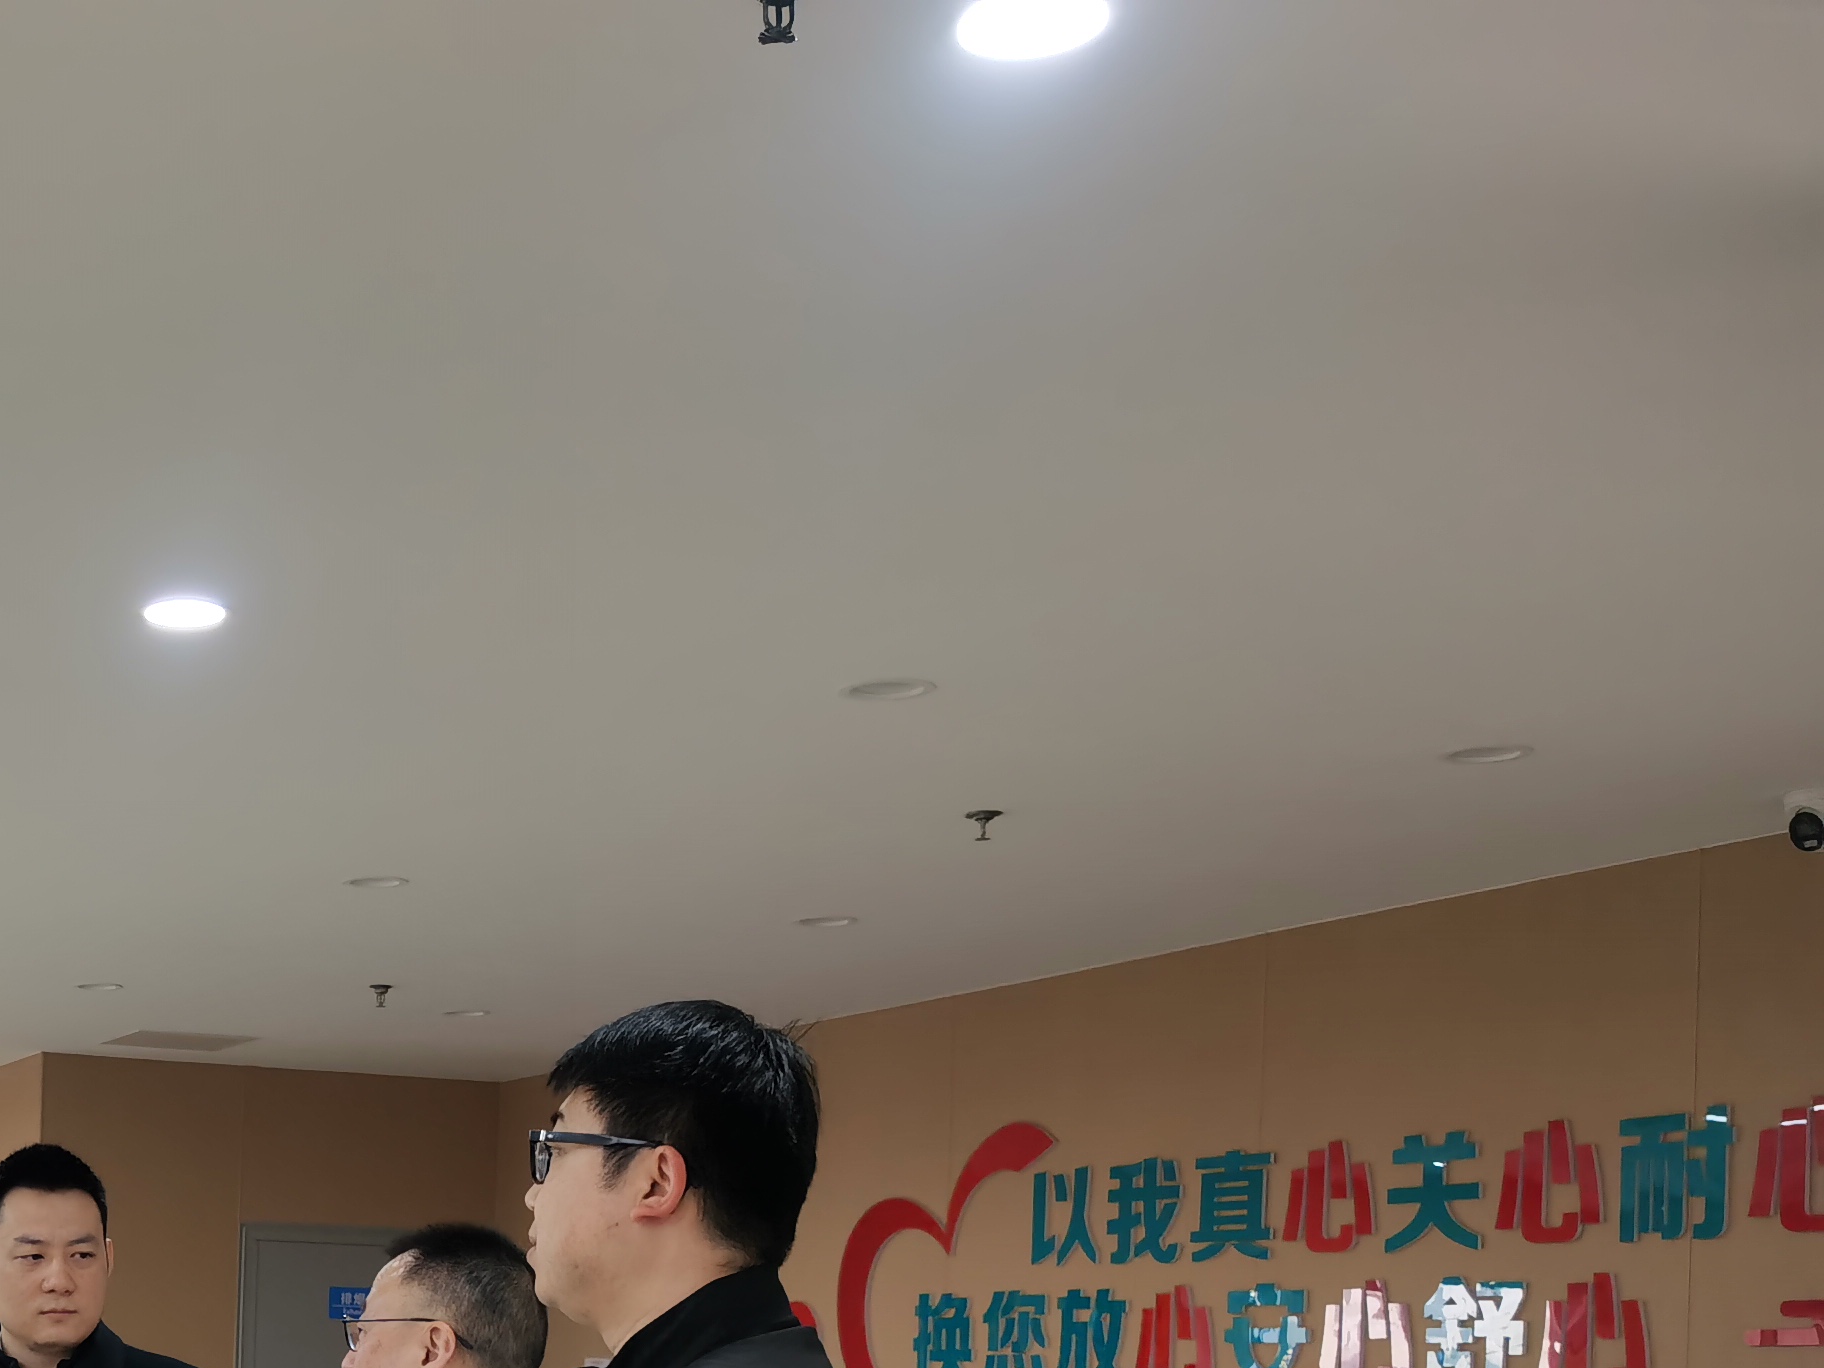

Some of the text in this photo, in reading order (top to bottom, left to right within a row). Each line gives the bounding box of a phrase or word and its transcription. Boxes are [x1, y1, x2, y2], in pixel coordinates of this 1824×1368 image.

[1031, 1096, 1824, 1267] 以我真心关心耐心
